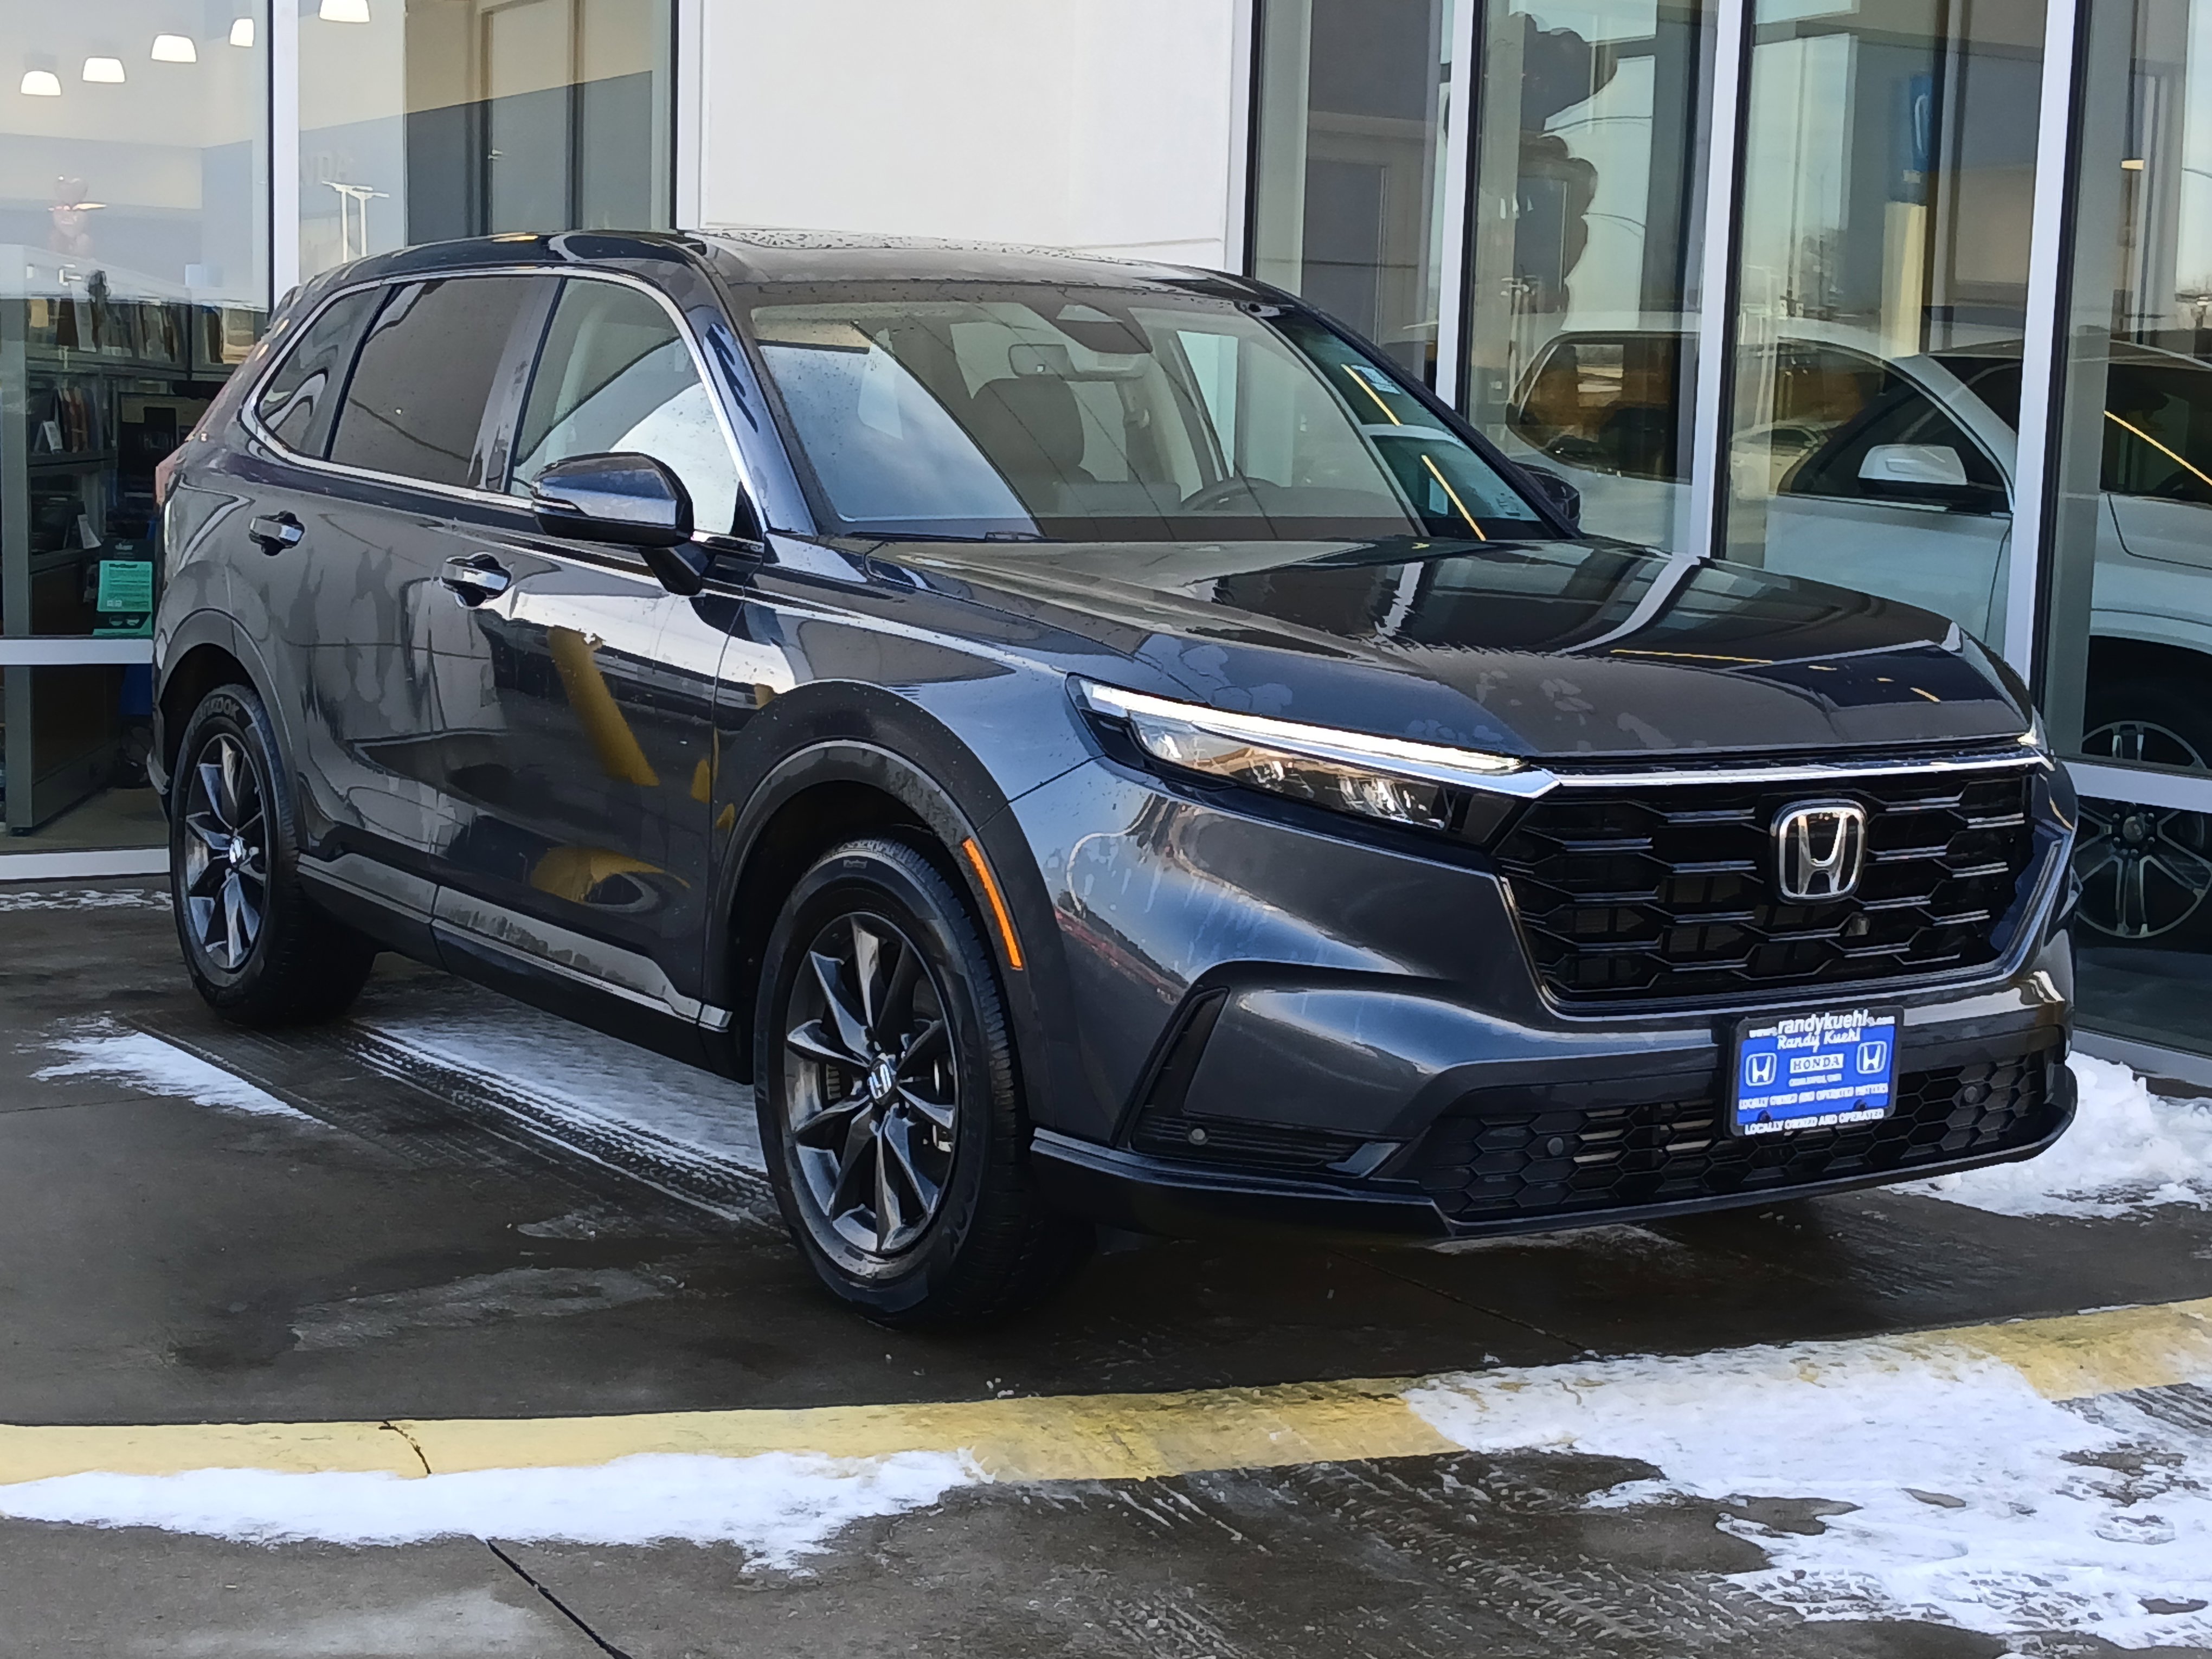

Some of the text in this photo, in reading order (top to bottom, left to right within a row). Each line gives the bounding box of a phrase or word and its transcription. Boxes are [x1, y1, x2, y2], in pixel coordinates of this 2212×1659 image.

[1777, 1027, 1861, 1053] Randy Kuehl
[1792, 1056, 1840, 1071] HONDA
[1745, 1120, 1784, 1135] LOCALLY
[1818, 1114, 1838, 1126] AND
